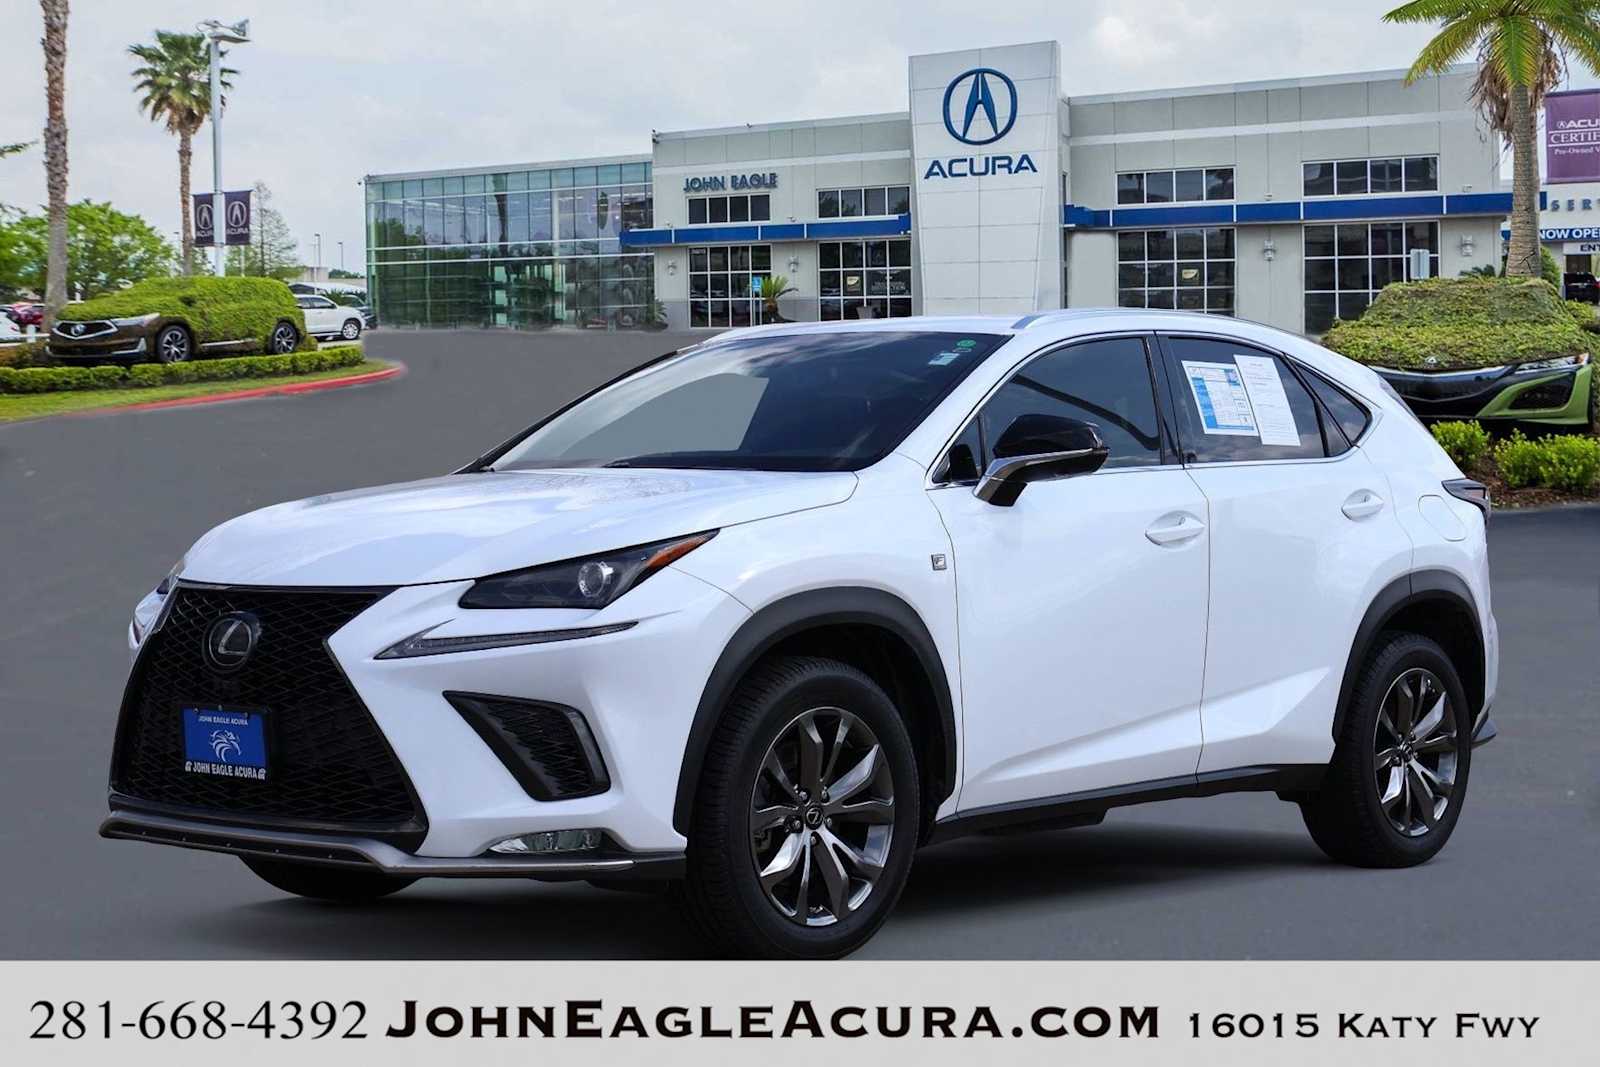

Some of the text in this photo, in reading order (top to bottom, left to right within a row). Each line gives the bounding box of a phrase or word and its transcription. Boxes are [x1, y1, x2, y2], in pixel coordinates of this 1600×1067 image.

[1566, 119, 1600, 128] ACU
[924, 154, 1038, 179] ACURA
[684, 173, 777, 192] JOHN EAGLE
[1540, 228, 1600, 239] NOW OPE
[199, 715, 248, 726] JOHN EAGLE ACURA
[193, 762, 258, 779] JOHN EAGLE ACURA
